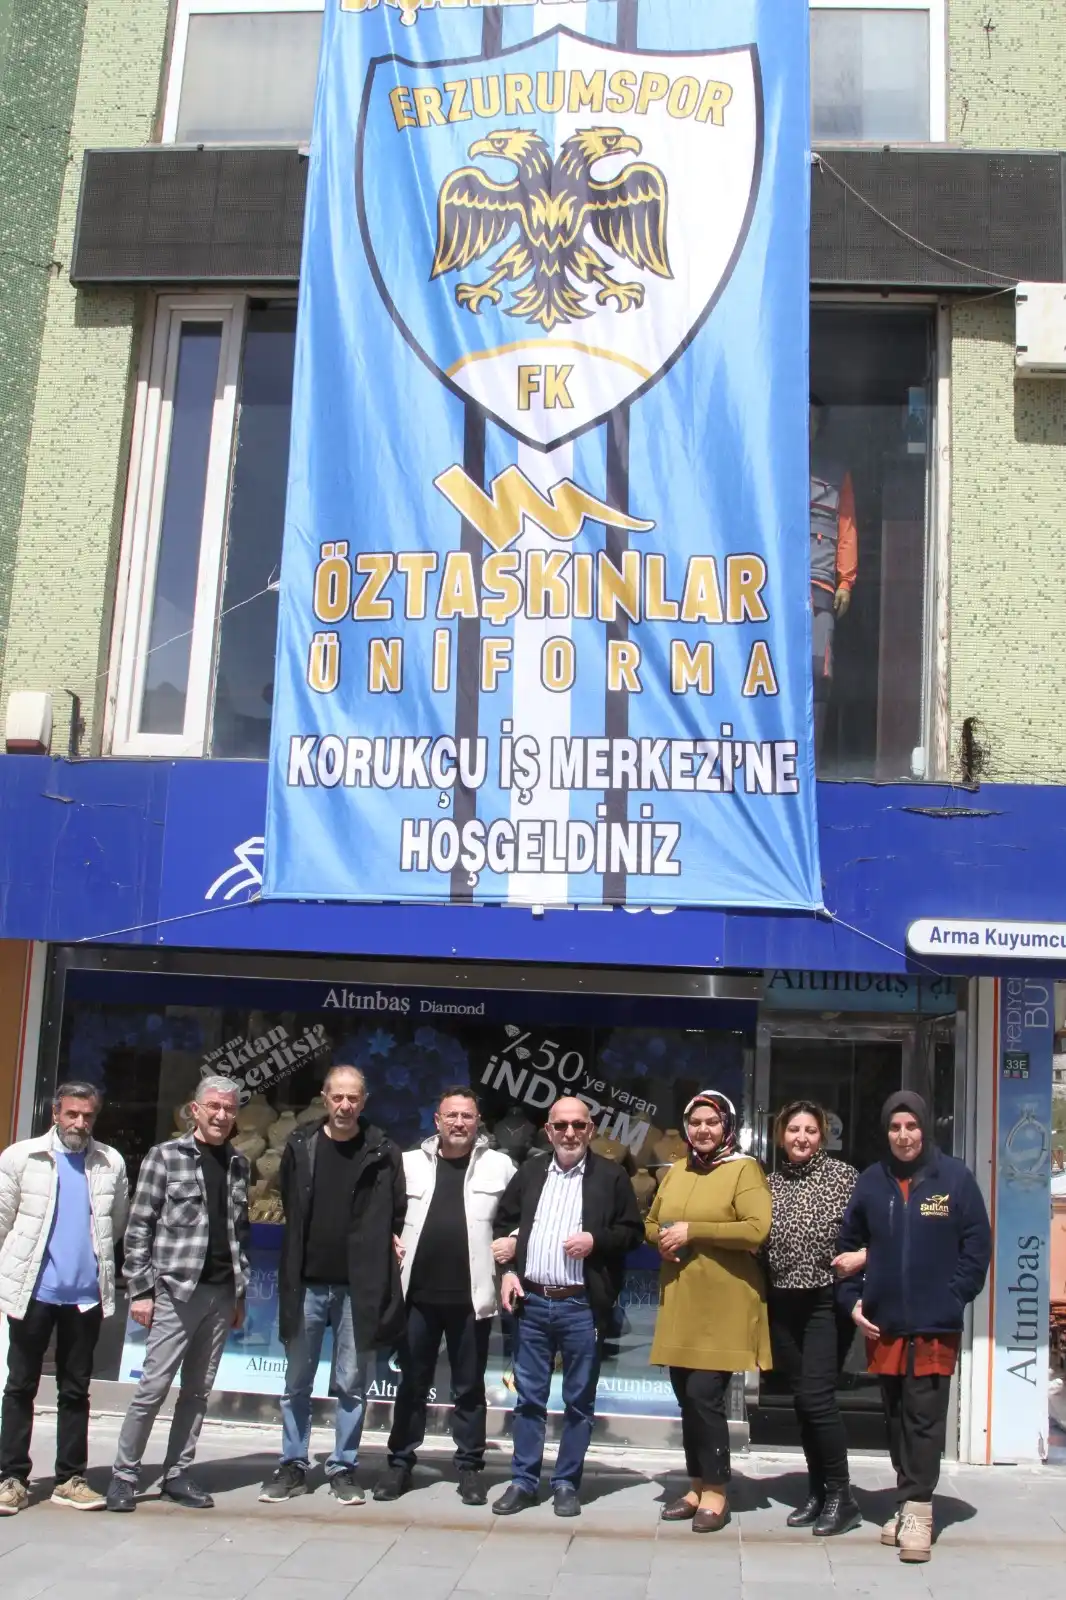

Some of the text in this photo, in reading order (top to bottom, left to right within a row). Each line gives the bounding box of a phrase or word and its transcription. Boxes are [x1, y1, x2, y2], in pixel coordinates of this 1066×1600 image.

[389, 70, 733, 132] ERZURUMSPOR
[516, 364, 575, 411] FK
[312, 540, 770, 627] ÖZTAŞKINLAR
[306, 628, 780, 697] ÜNİFORMA
[287, 719, 799, 809] KORUKÇU İŞ MERKEZİ'NE
[400, 804, 682, 887] HOŞGELDİNİZ
[929, 926, 1066, 951] Arma Kuyumcu
[322, 988, 485, 1016] Altınbaş Diamond
[1006, 1059, 1028, 1070] 33E
[480, 1055, 651, 1157] iNDiM
[610, 1086, 658, 1116] varan
[1006, 1235, 1046, 1387] Altınbaş
[246, 1357, 288, 1373] Altın
[366, 1380, 438, 1402] Altış
